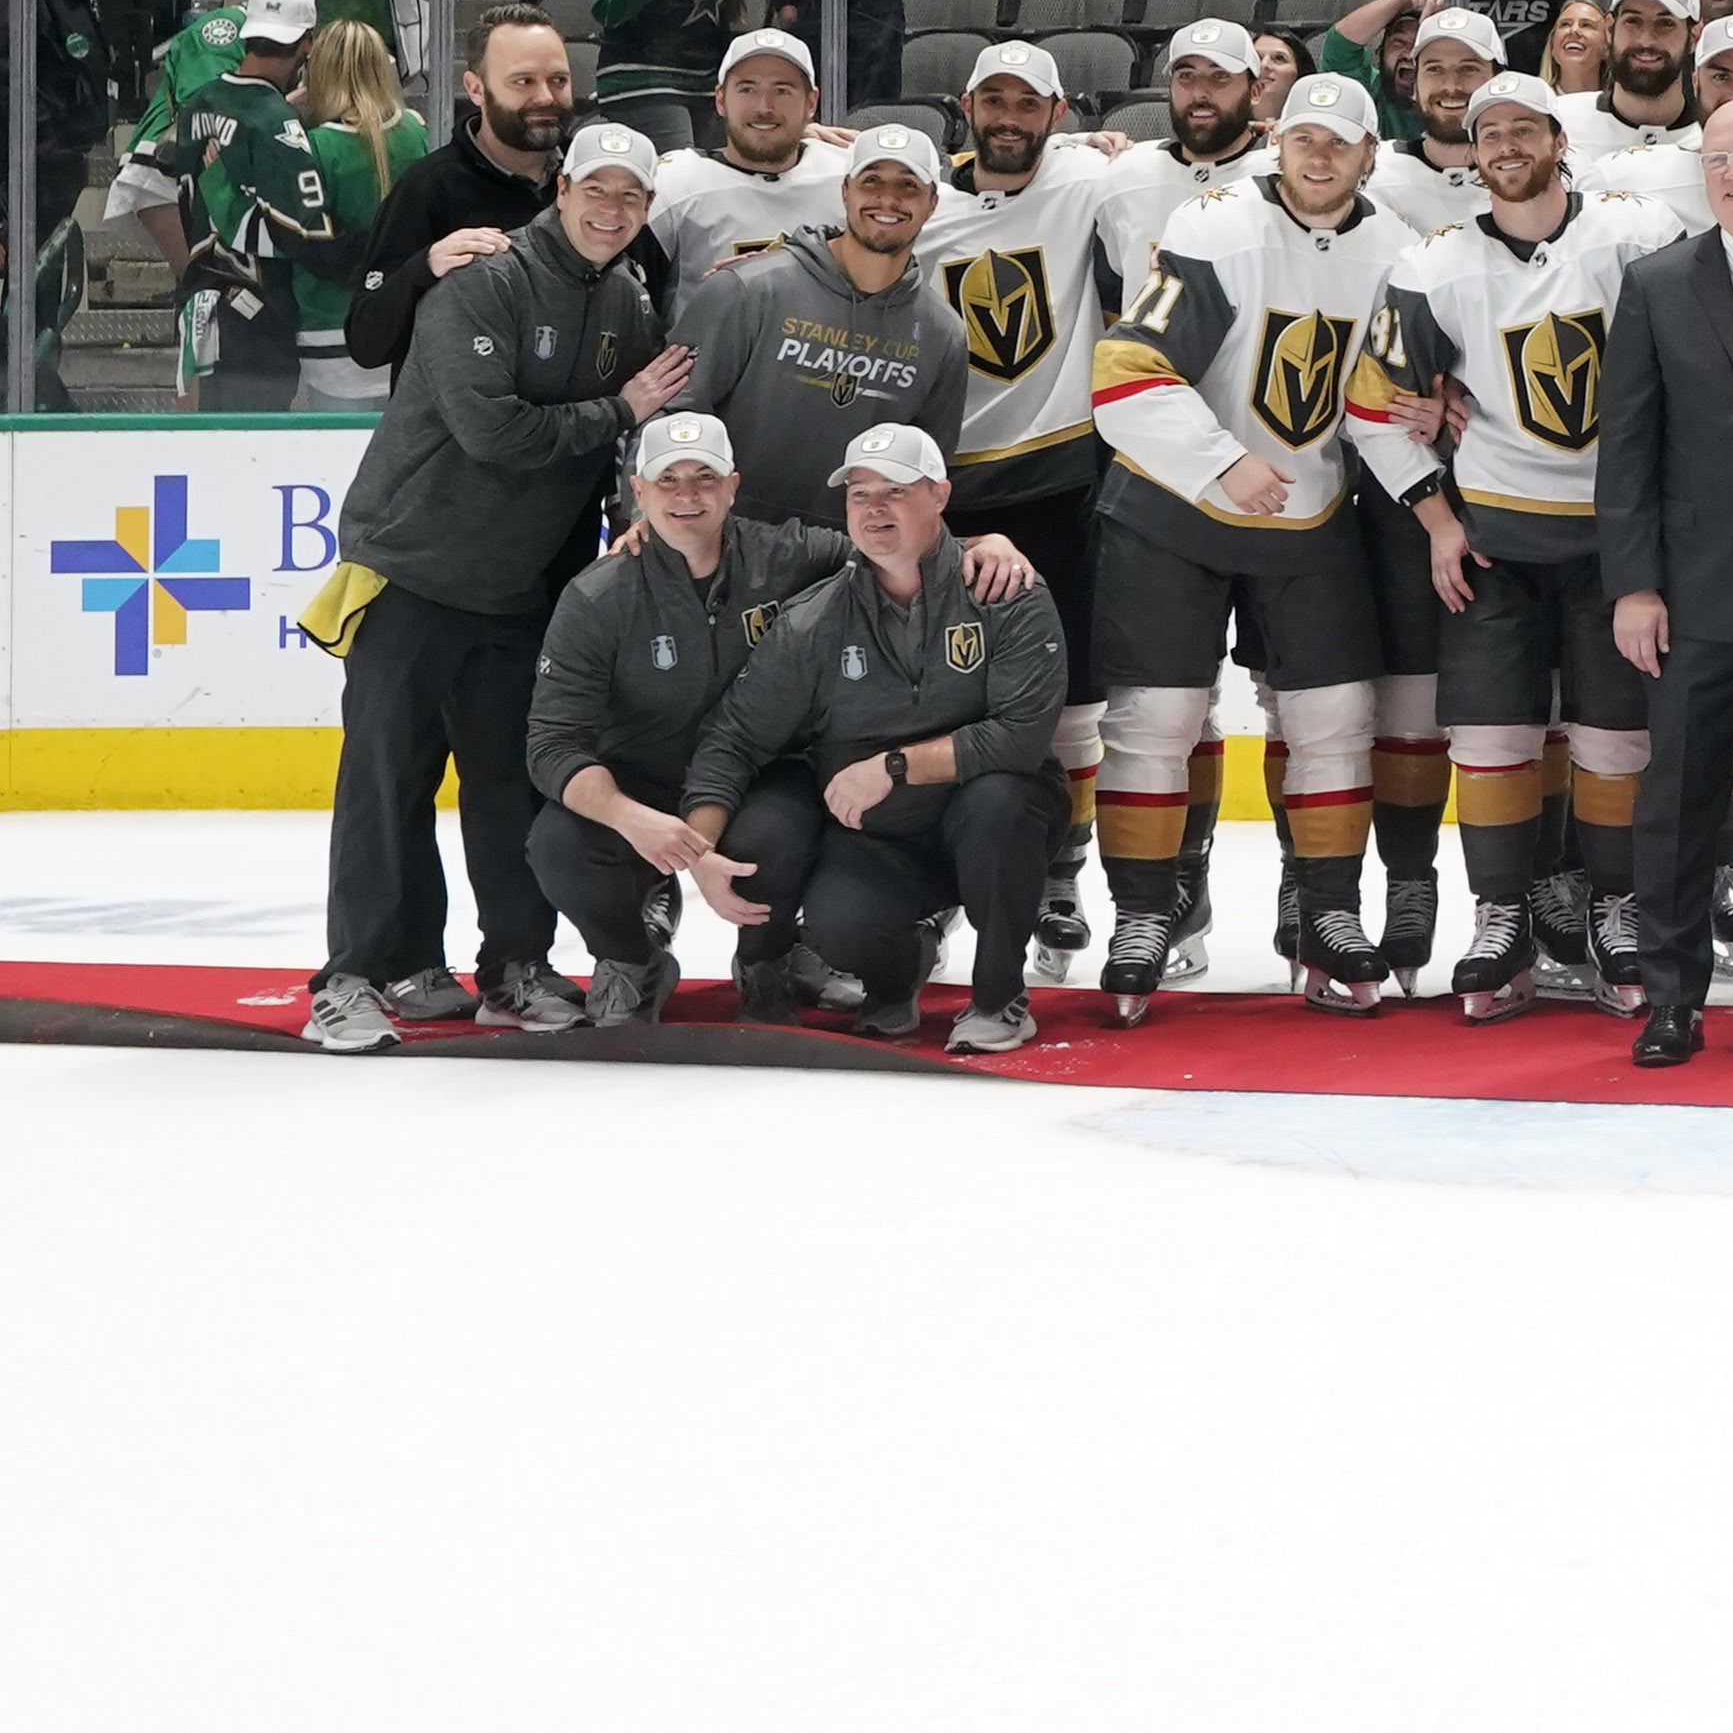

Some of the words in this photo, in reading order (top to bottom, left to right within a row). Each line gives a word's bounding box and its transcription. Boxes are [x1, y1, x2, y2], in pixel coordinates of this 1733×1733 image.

[298, 169, 326, 207] 9
[781, 317, 879, 353] STANLEY
[883, 338, 920, 361] CUP
[1370, 306, 1407, 369] 81
[776, 337, 918, 389] PLAYOFFS
